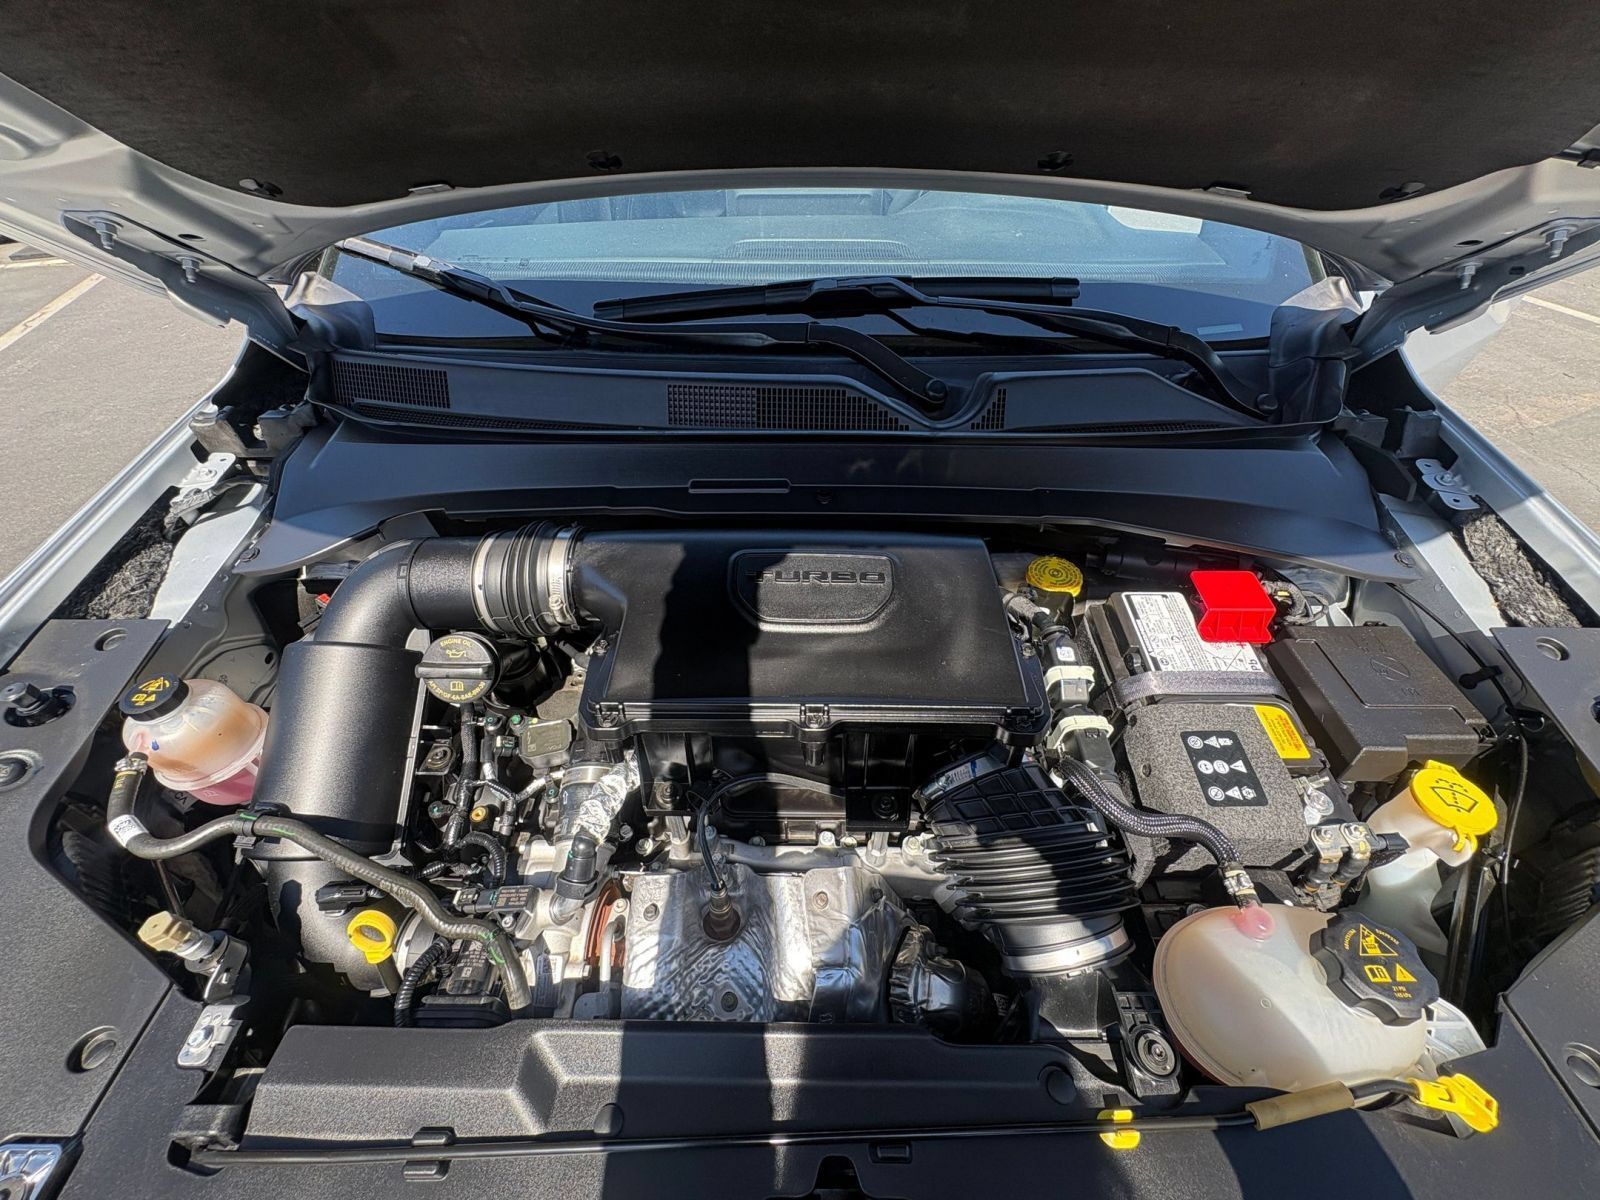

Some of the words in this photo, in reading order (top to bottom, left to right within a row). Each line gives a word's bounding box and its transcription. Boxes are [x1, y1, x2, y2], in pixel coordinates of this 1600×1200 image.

[745, 570, 886, 584] TURBO
[440, 638, 461, 647] ENGINE
[463, 639, 473, 648] OIL
